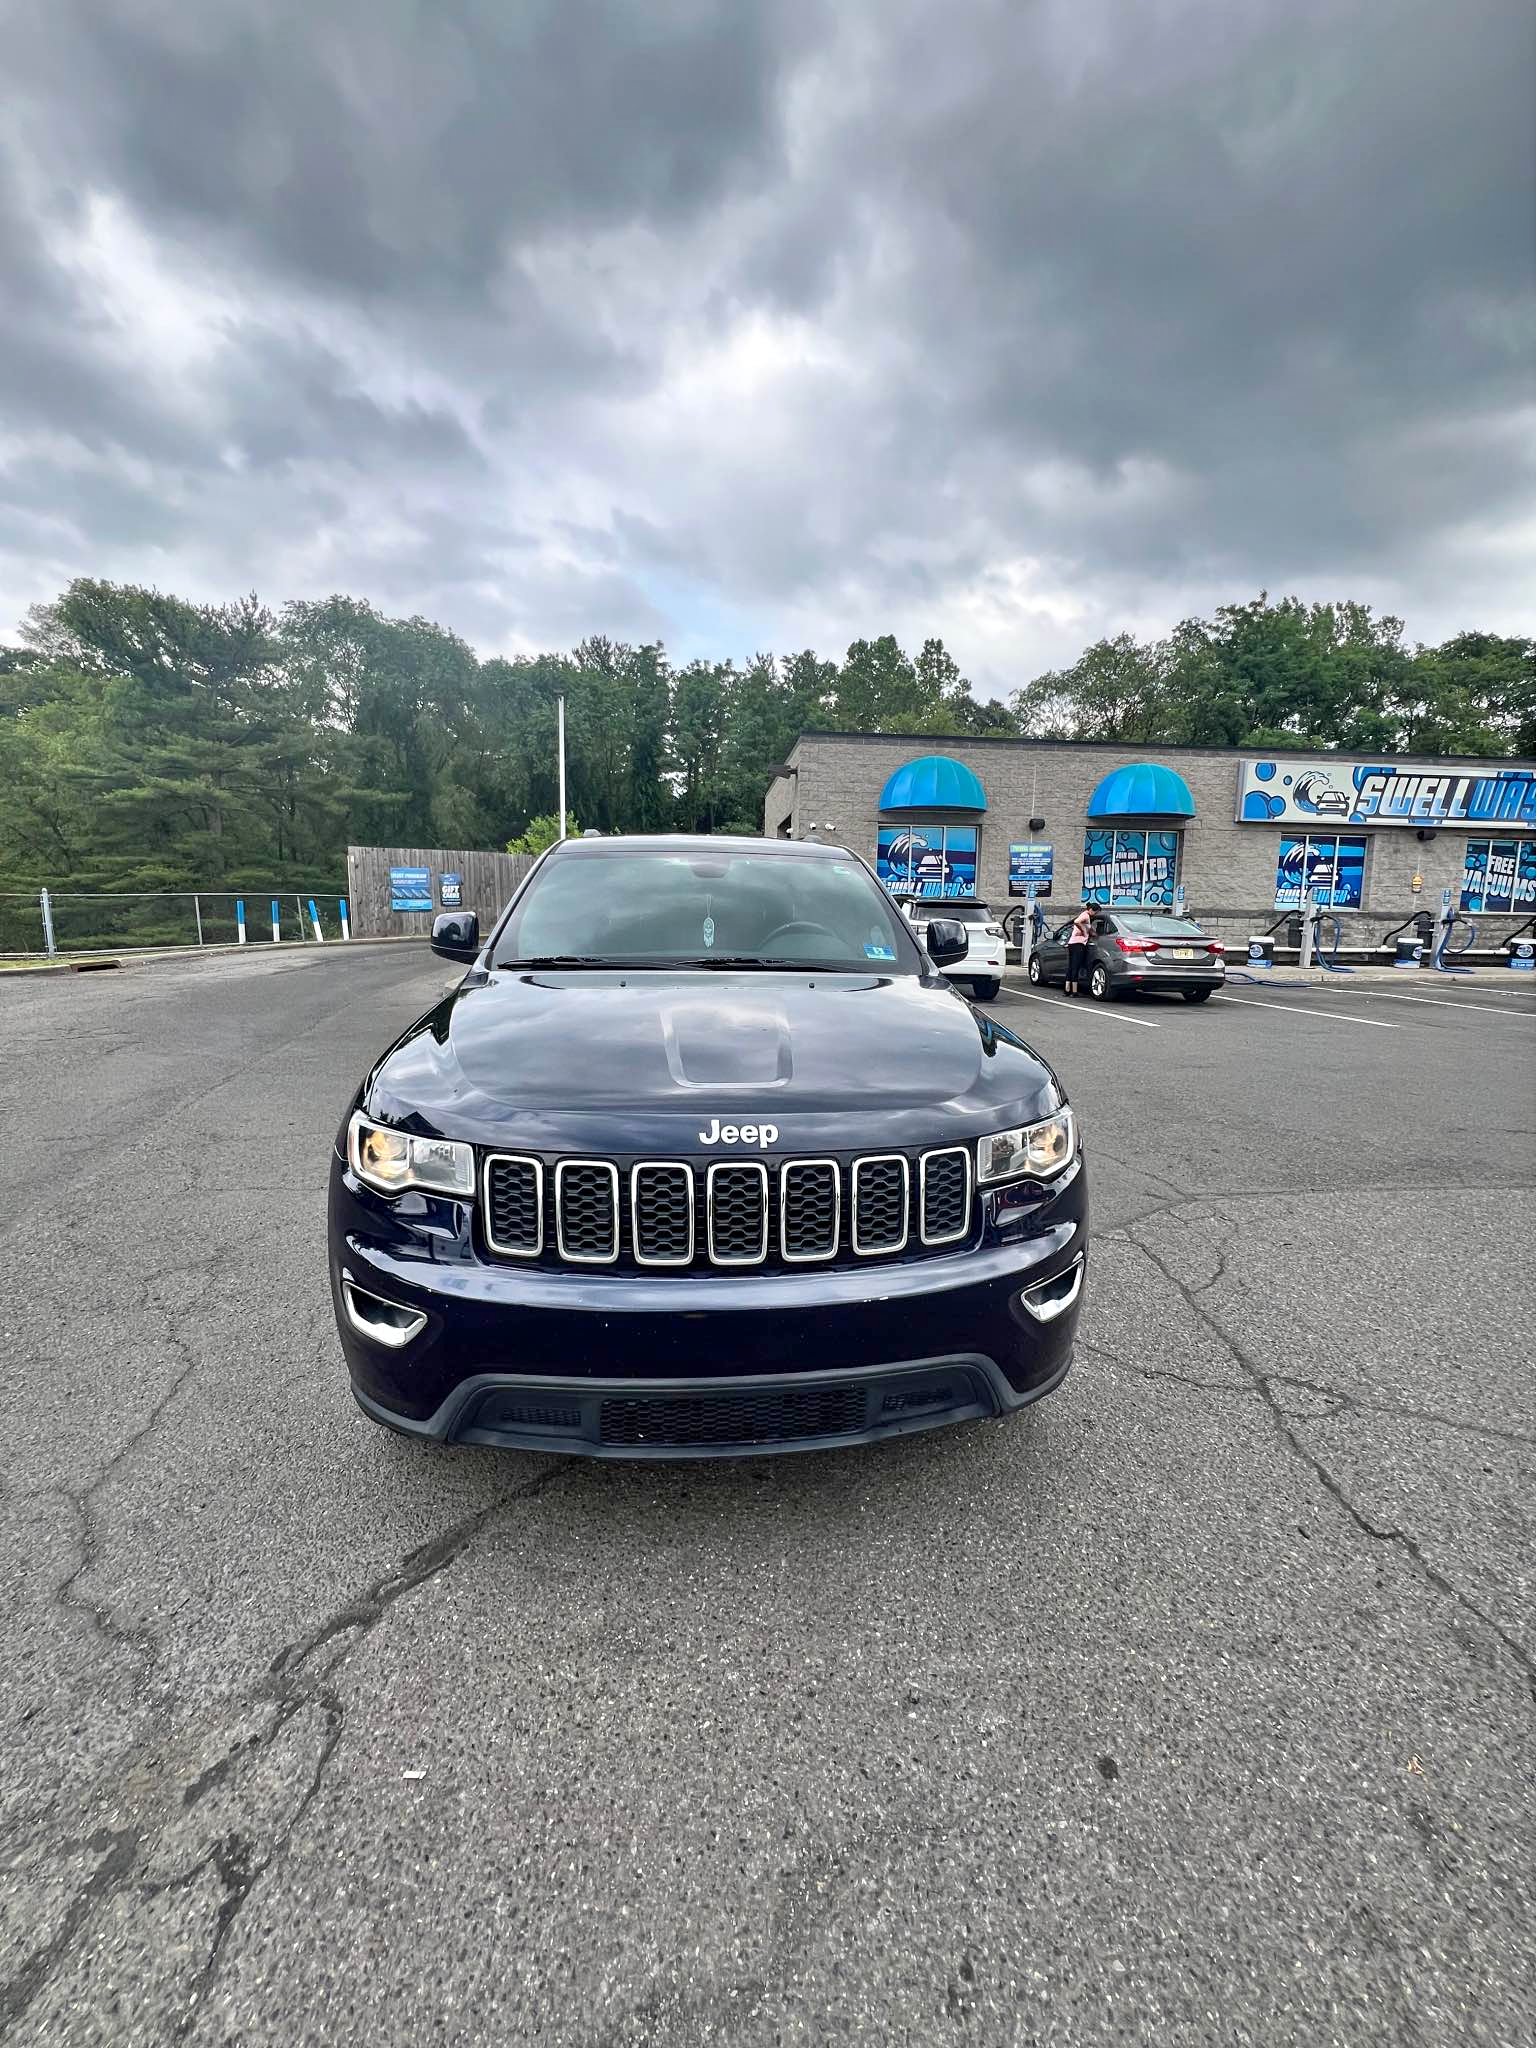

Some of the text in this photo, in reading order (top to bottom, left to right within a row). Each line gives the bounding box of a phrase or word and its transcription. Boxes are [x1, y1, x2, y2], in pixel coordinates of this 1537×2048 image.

[1356, 776, 1470, 818] SWELL
[1488, 855, 1516, 875] FREE
[441, 885, 460, 893] GIFT
[1461, 868, 1536, 902] VACUUMS
[698, 1119, 779, 1149] Jeep
